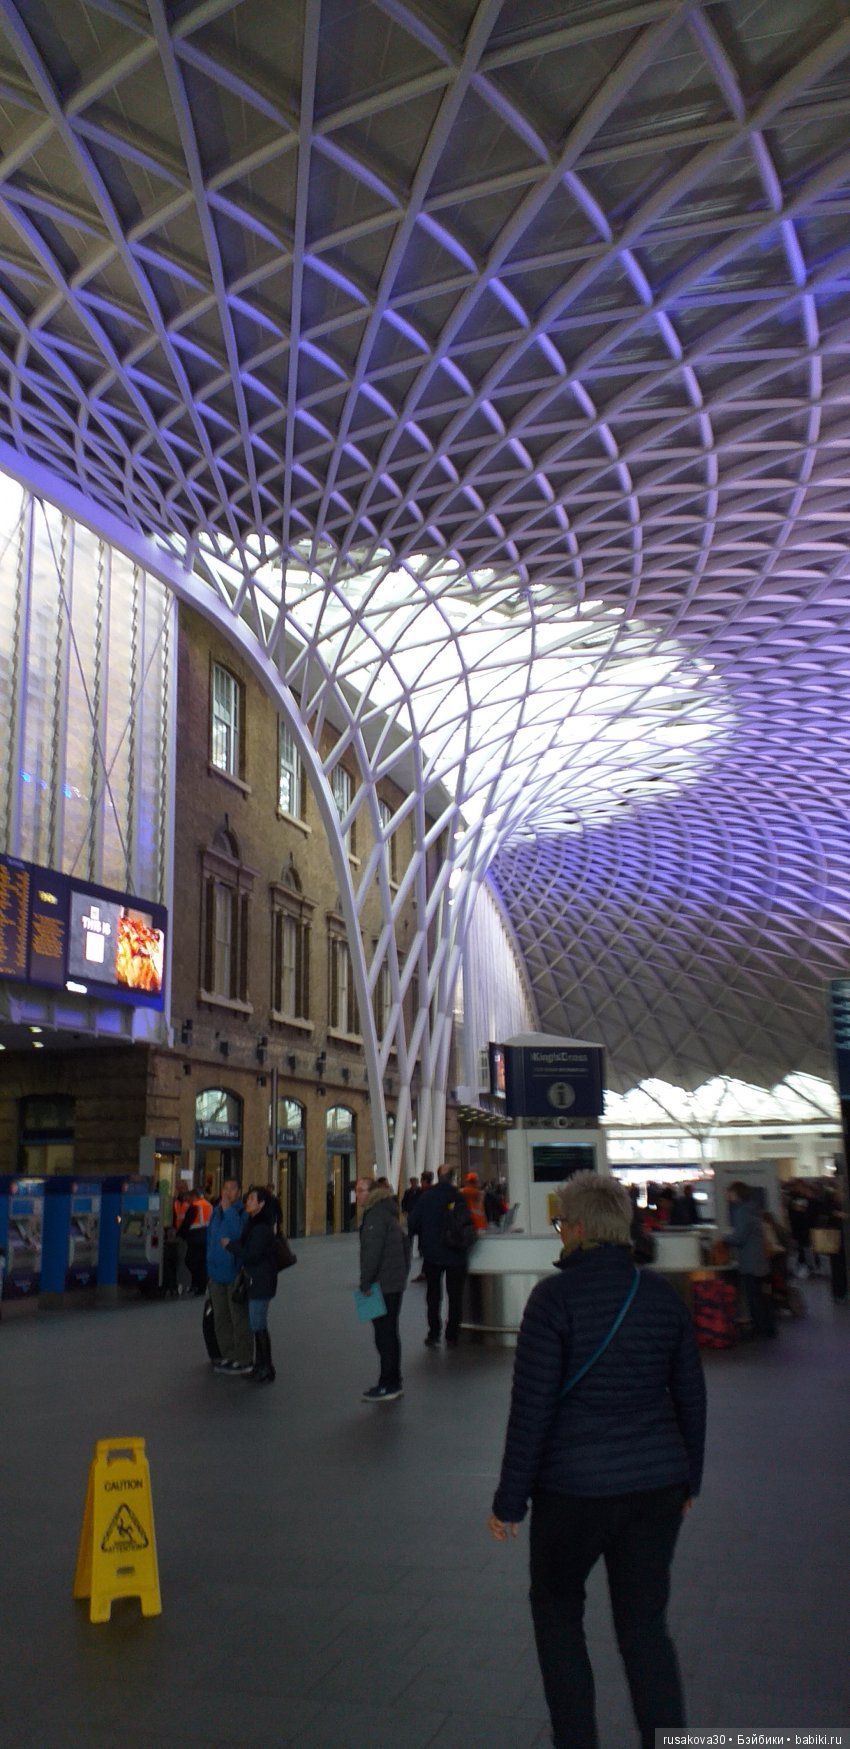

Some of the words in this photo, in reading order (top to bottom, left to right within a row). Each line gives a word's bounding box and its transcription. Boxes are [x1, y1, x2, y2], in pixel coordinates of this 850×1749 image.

[82, 916, 102, 933] THIS
[103, 922, 112, 935] IS
[104, 1480, 143, 1491] CAUTION
